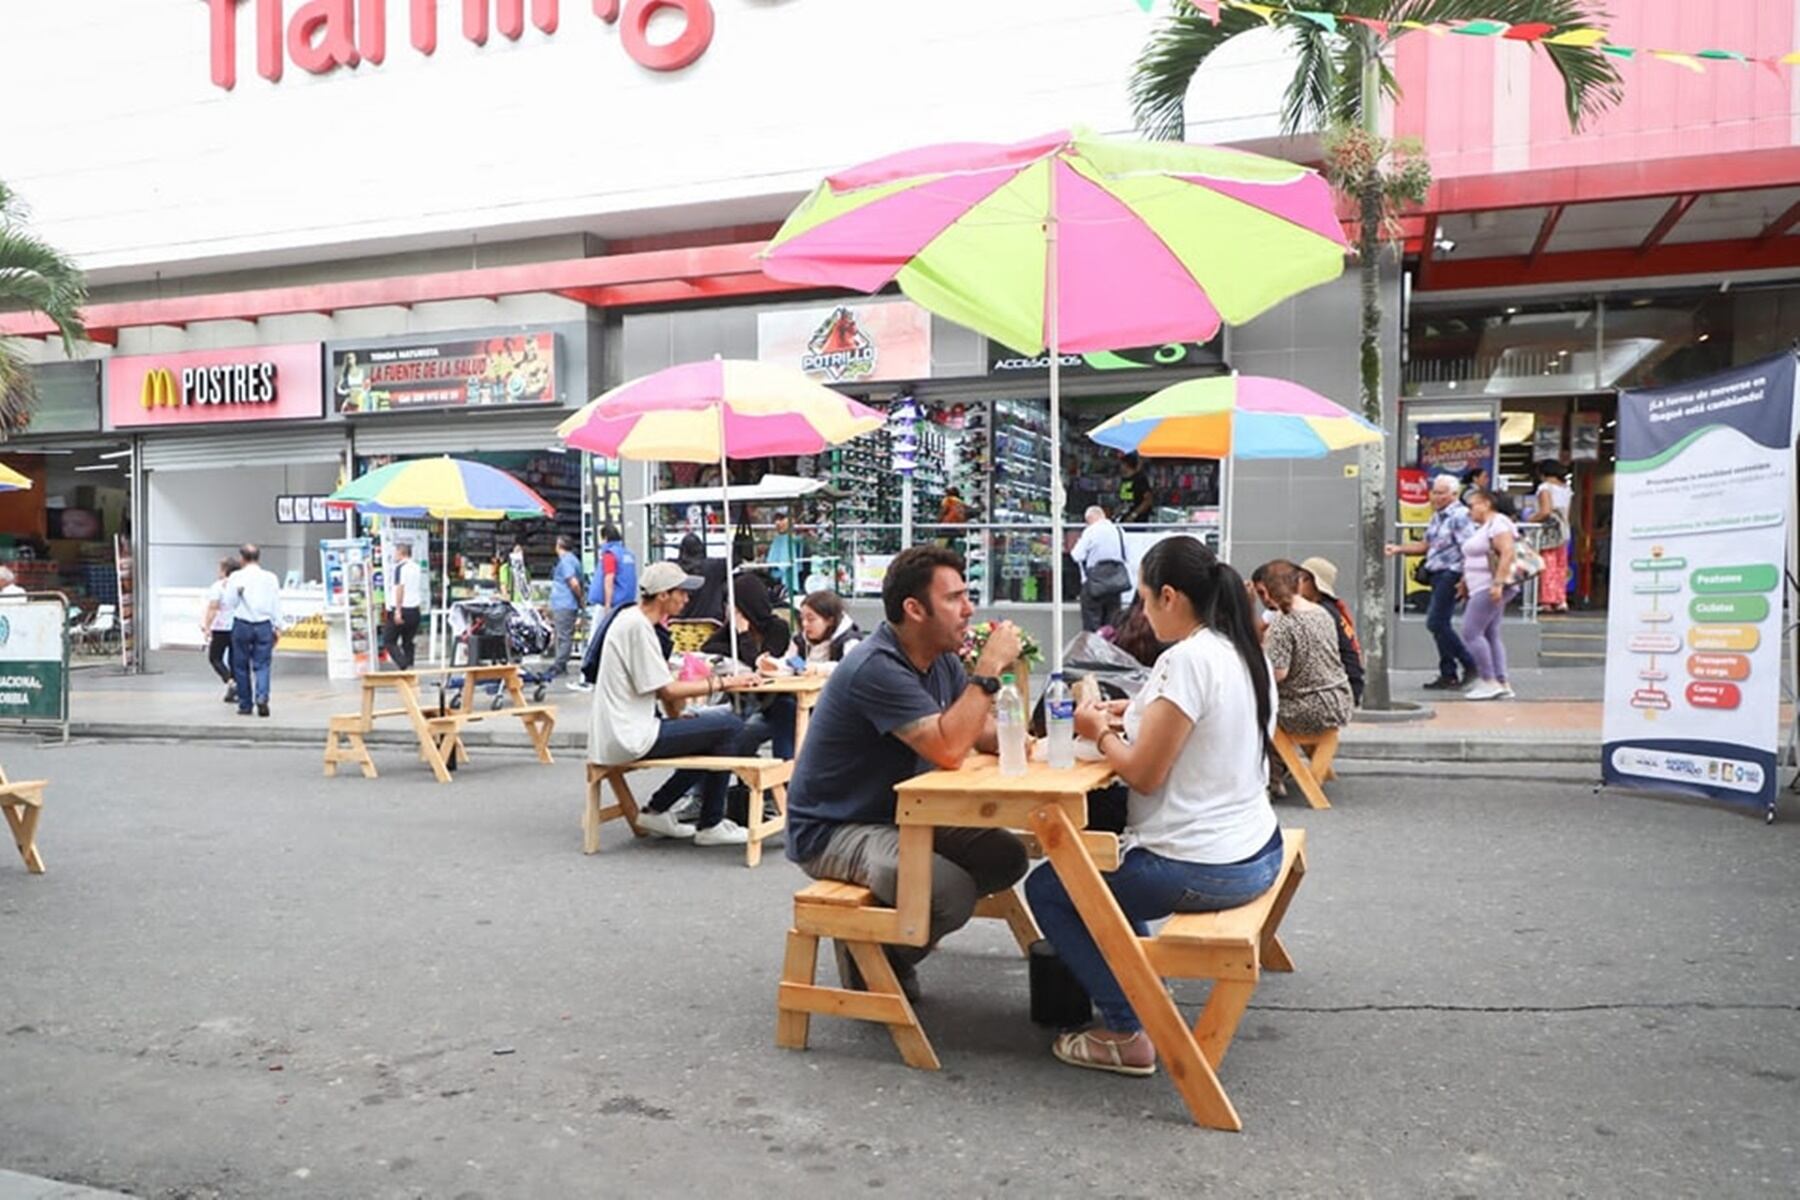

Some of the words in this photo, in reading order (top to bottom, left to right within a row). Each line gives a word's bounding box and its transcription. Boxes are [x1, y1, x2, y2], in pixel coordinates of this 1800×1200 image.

[371, 366, 383, 383] LA
[384, 362, 422, 382] FUENTE
[423, 361, 437, 379] DE
[438, 359, 451, 377] LA
[454, 356, 487, 377] SALUD
[802, 348, 873, 371] POTRILLO
[994, 356, 1082, 370] ACCESOIOS
[182, 361, 276, 407] POSTRES
[1665, 394, 1694, 407] forma
[1696, 389, 1709, 400] de
[1710, 380, 1751, 397] moverse
[1752, 376, 1767, 387] en
[1697, 574, 1742, 585] Peatones
[1695, 602, 1735, 613] Ciclistas
